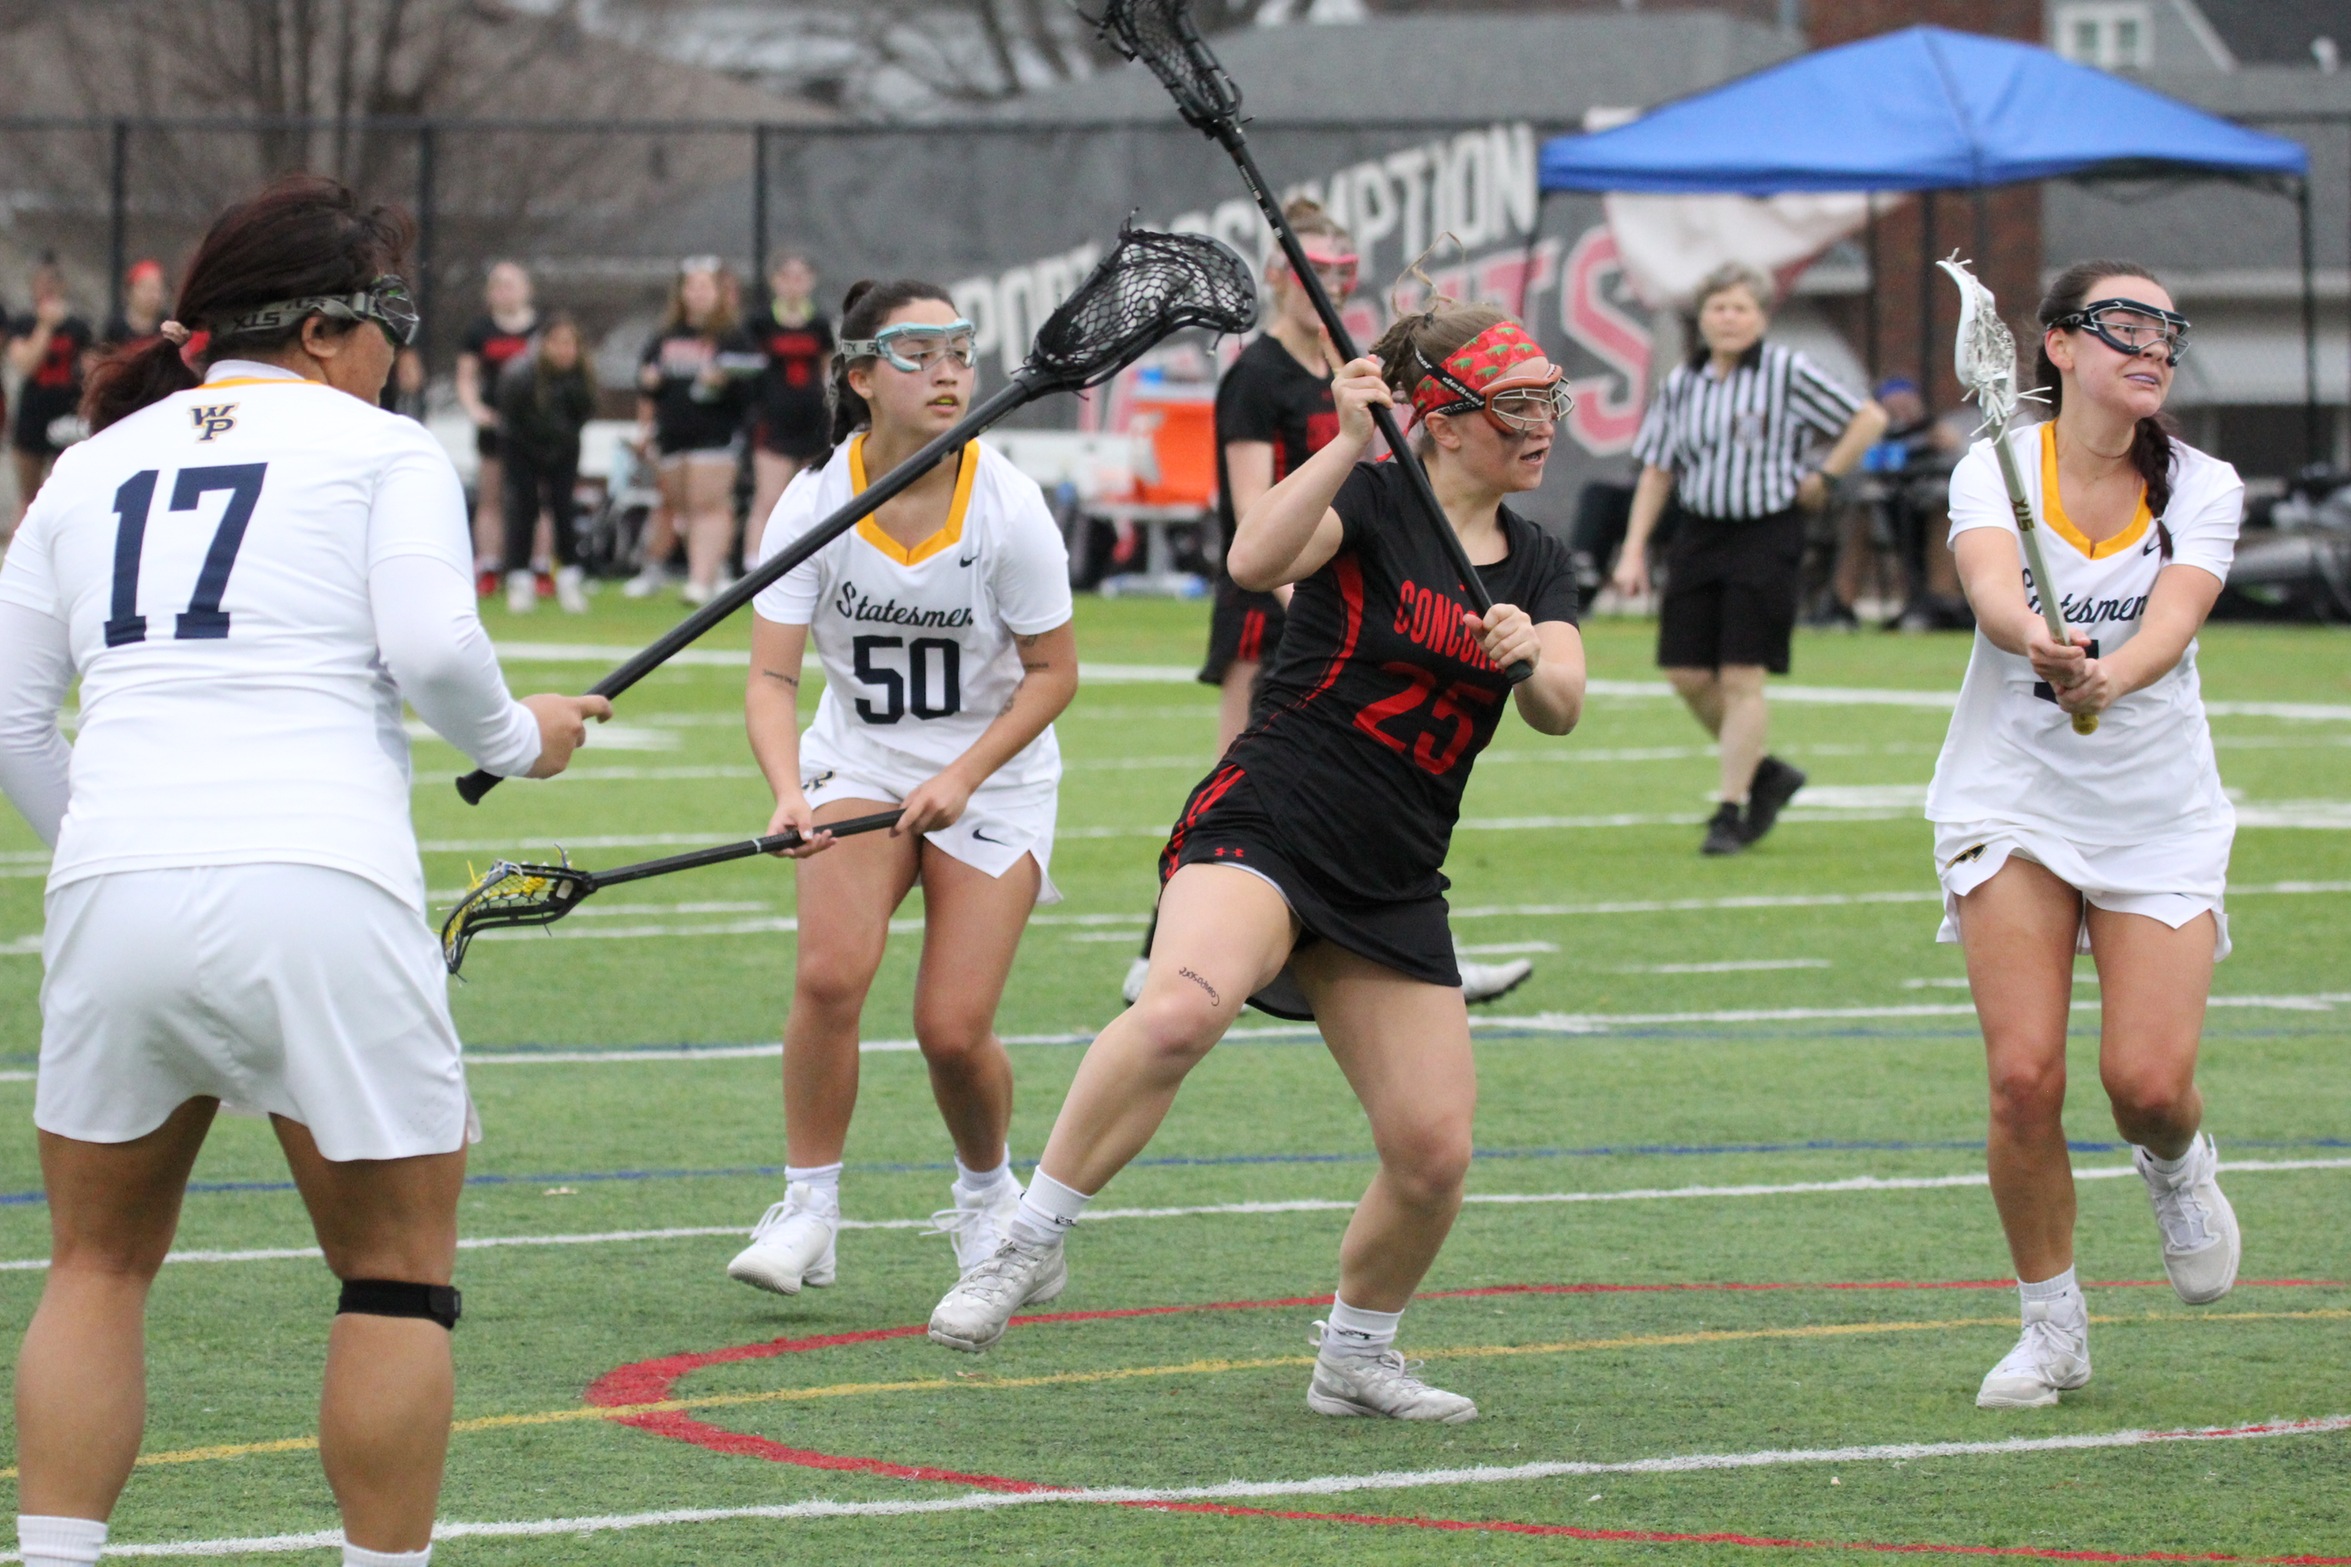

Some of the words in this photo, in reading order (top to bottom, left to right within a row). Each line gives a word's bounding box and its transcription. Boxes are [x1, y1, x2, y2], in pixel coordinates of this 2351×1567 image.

[104, 461, 268, 648] 17
[852, 634, 961, 725] 50
[1352, 660, 1500, 776] 25
